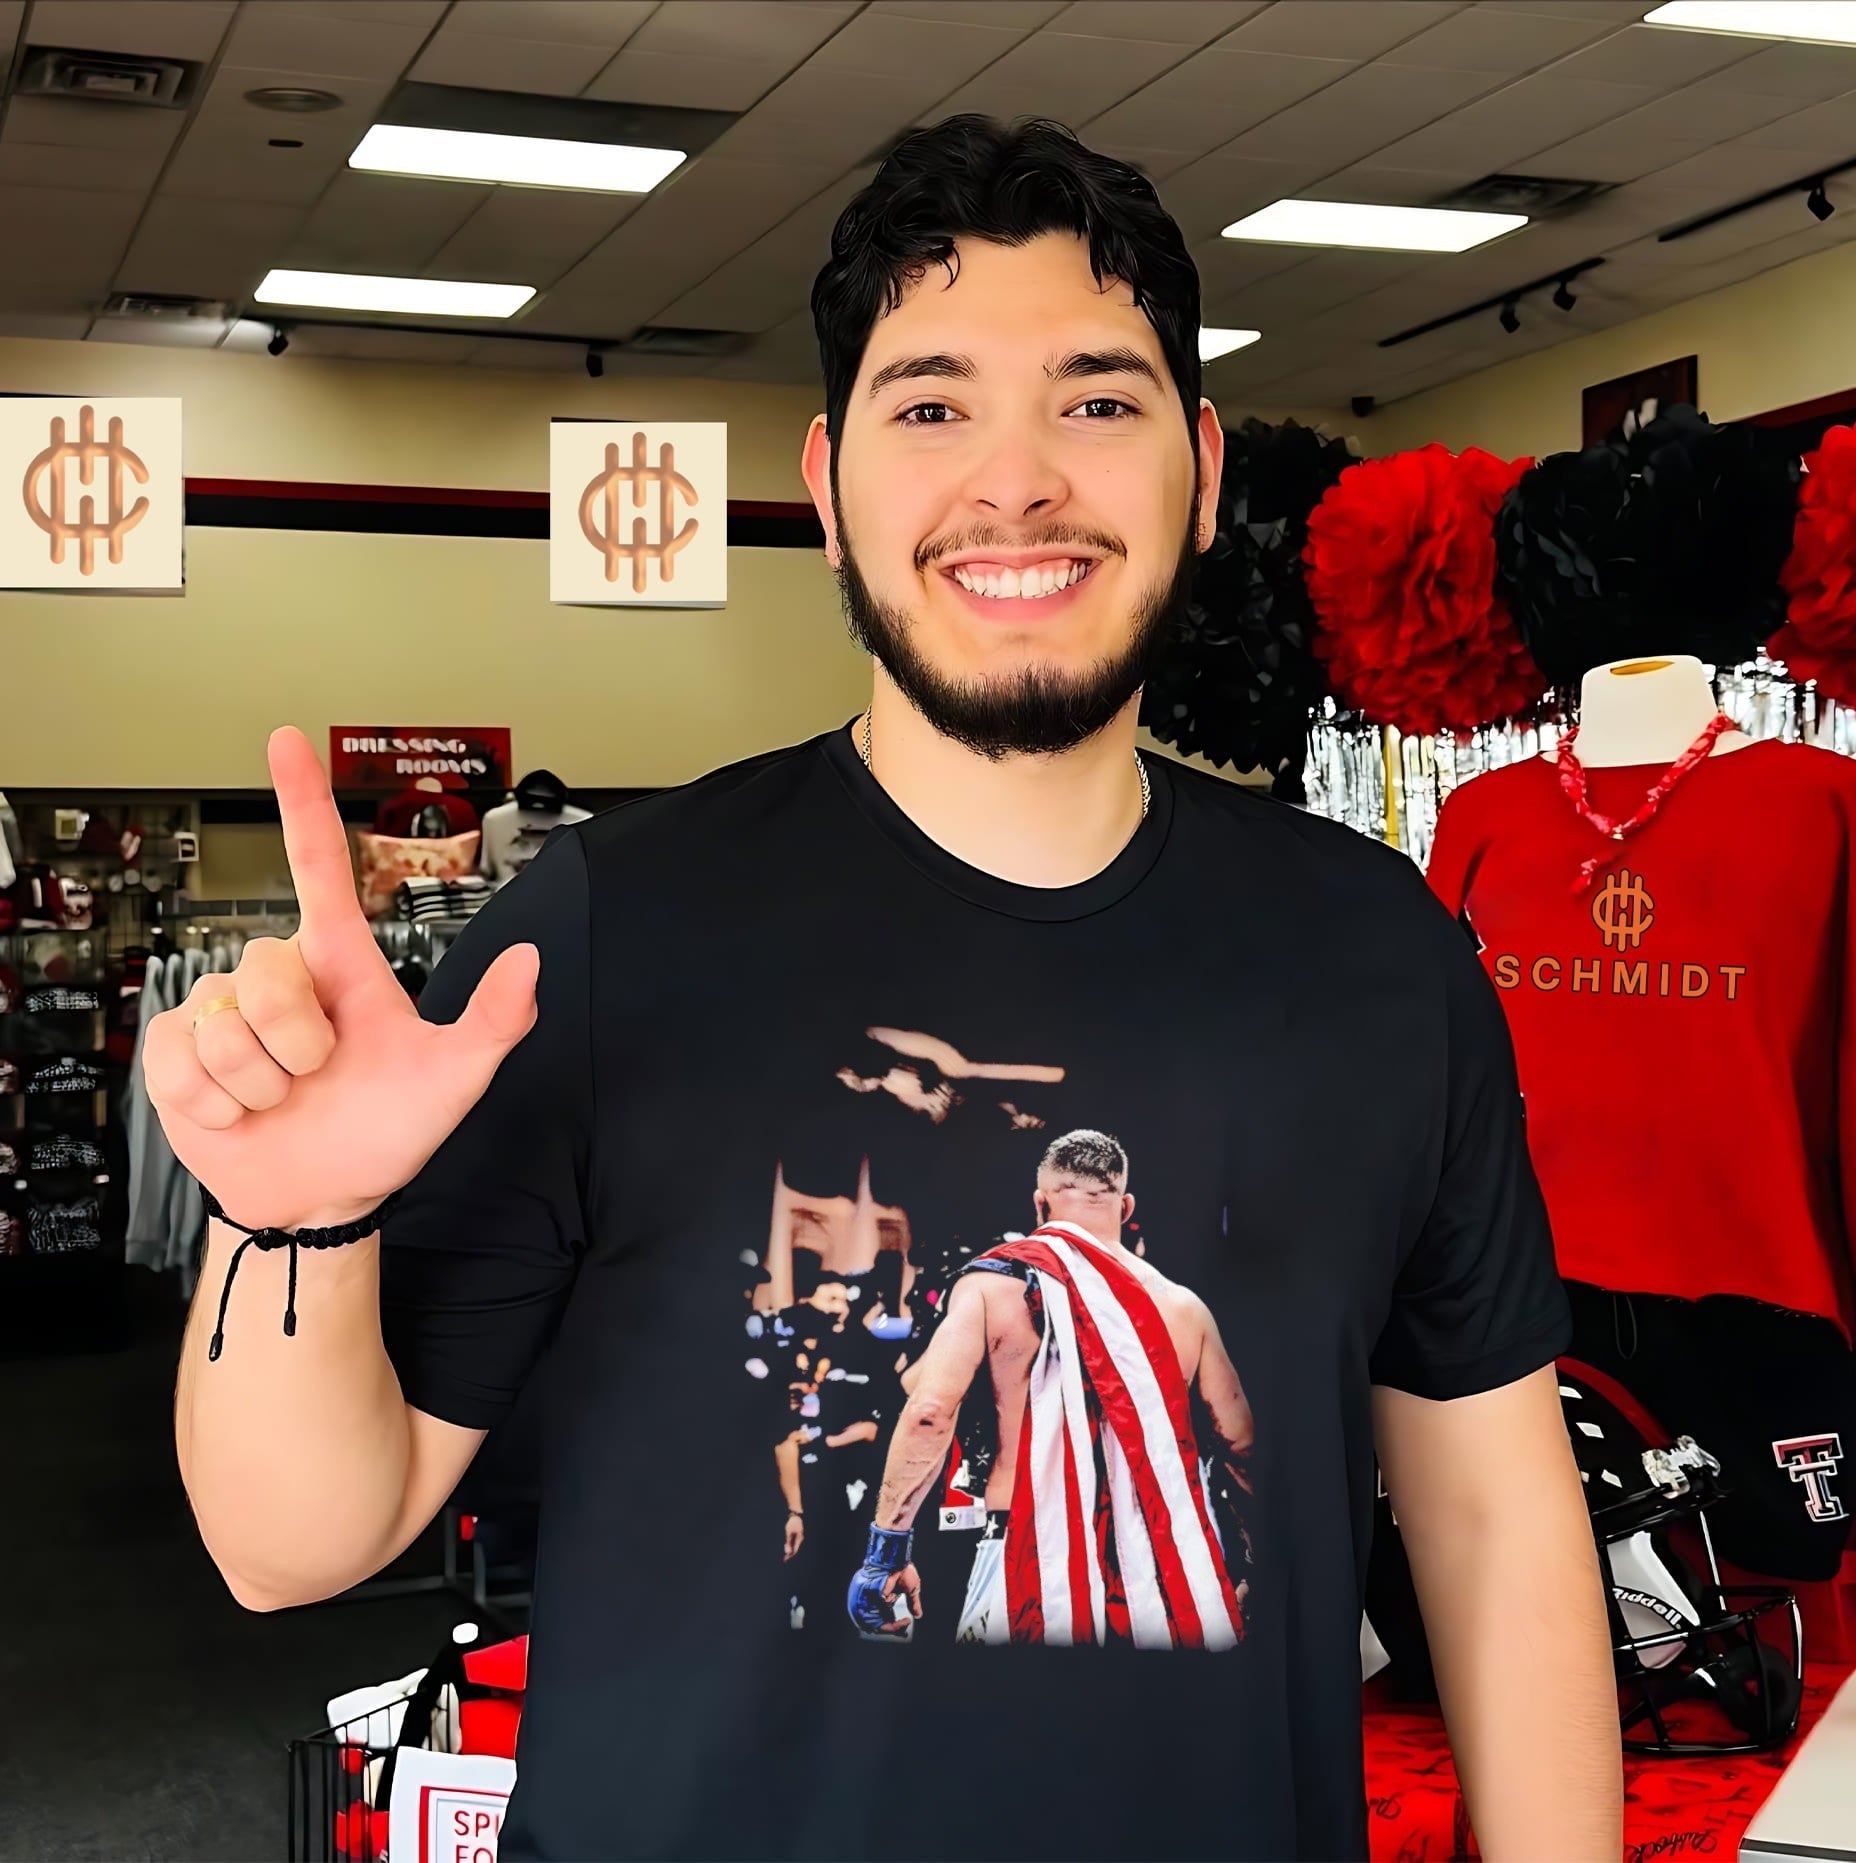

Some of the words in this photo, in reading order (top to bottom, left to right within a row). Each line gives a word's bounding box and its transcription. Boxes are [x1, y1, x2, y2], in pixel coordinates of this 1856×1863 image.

[342, 737, 467, 754] DRESSING
[396, 758, 487, 775] ROOMS
[1494, 954, 1747, 1000] SCHMIDT
